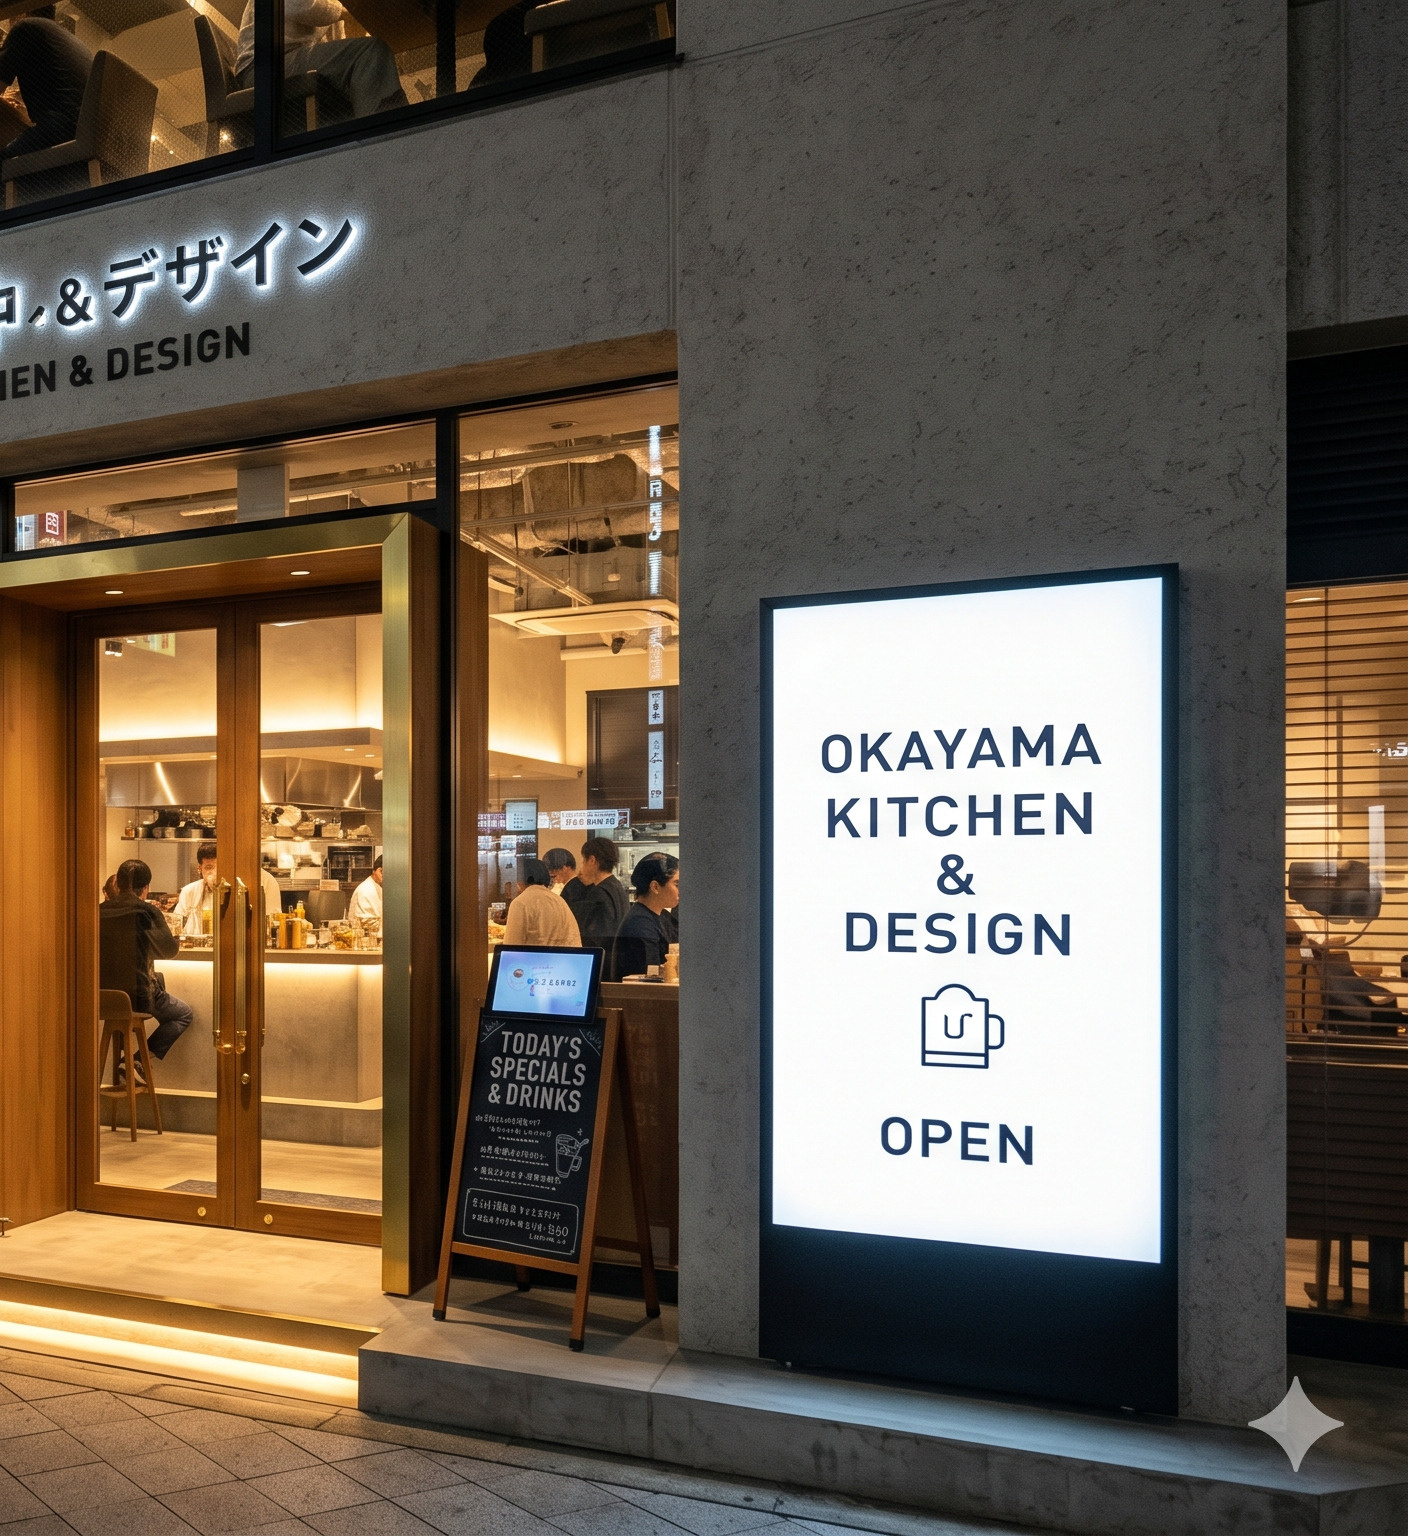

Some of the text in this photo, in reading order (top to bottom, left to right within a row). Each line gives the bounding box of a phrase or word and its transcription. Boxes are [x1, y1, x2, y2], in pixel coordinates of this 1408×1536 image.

[69, 354, 93, 387] &
[107, 322, 251, 381] DESIGN
[821, 723, 1102, 774] OKAYAMA
[827, 791, 1093, 838] KITCHEN
[936, 854, 976, 895] &
[845, 912, 1071, 956] DESIGN
[501, 1031, 582, 1059] TODAY'S
[490, 1056, 587, 1086] SPECIALS
[488, 1083, 582, 1113] & DRINKS
[880, 1116, 1033, 1165] OPEN
